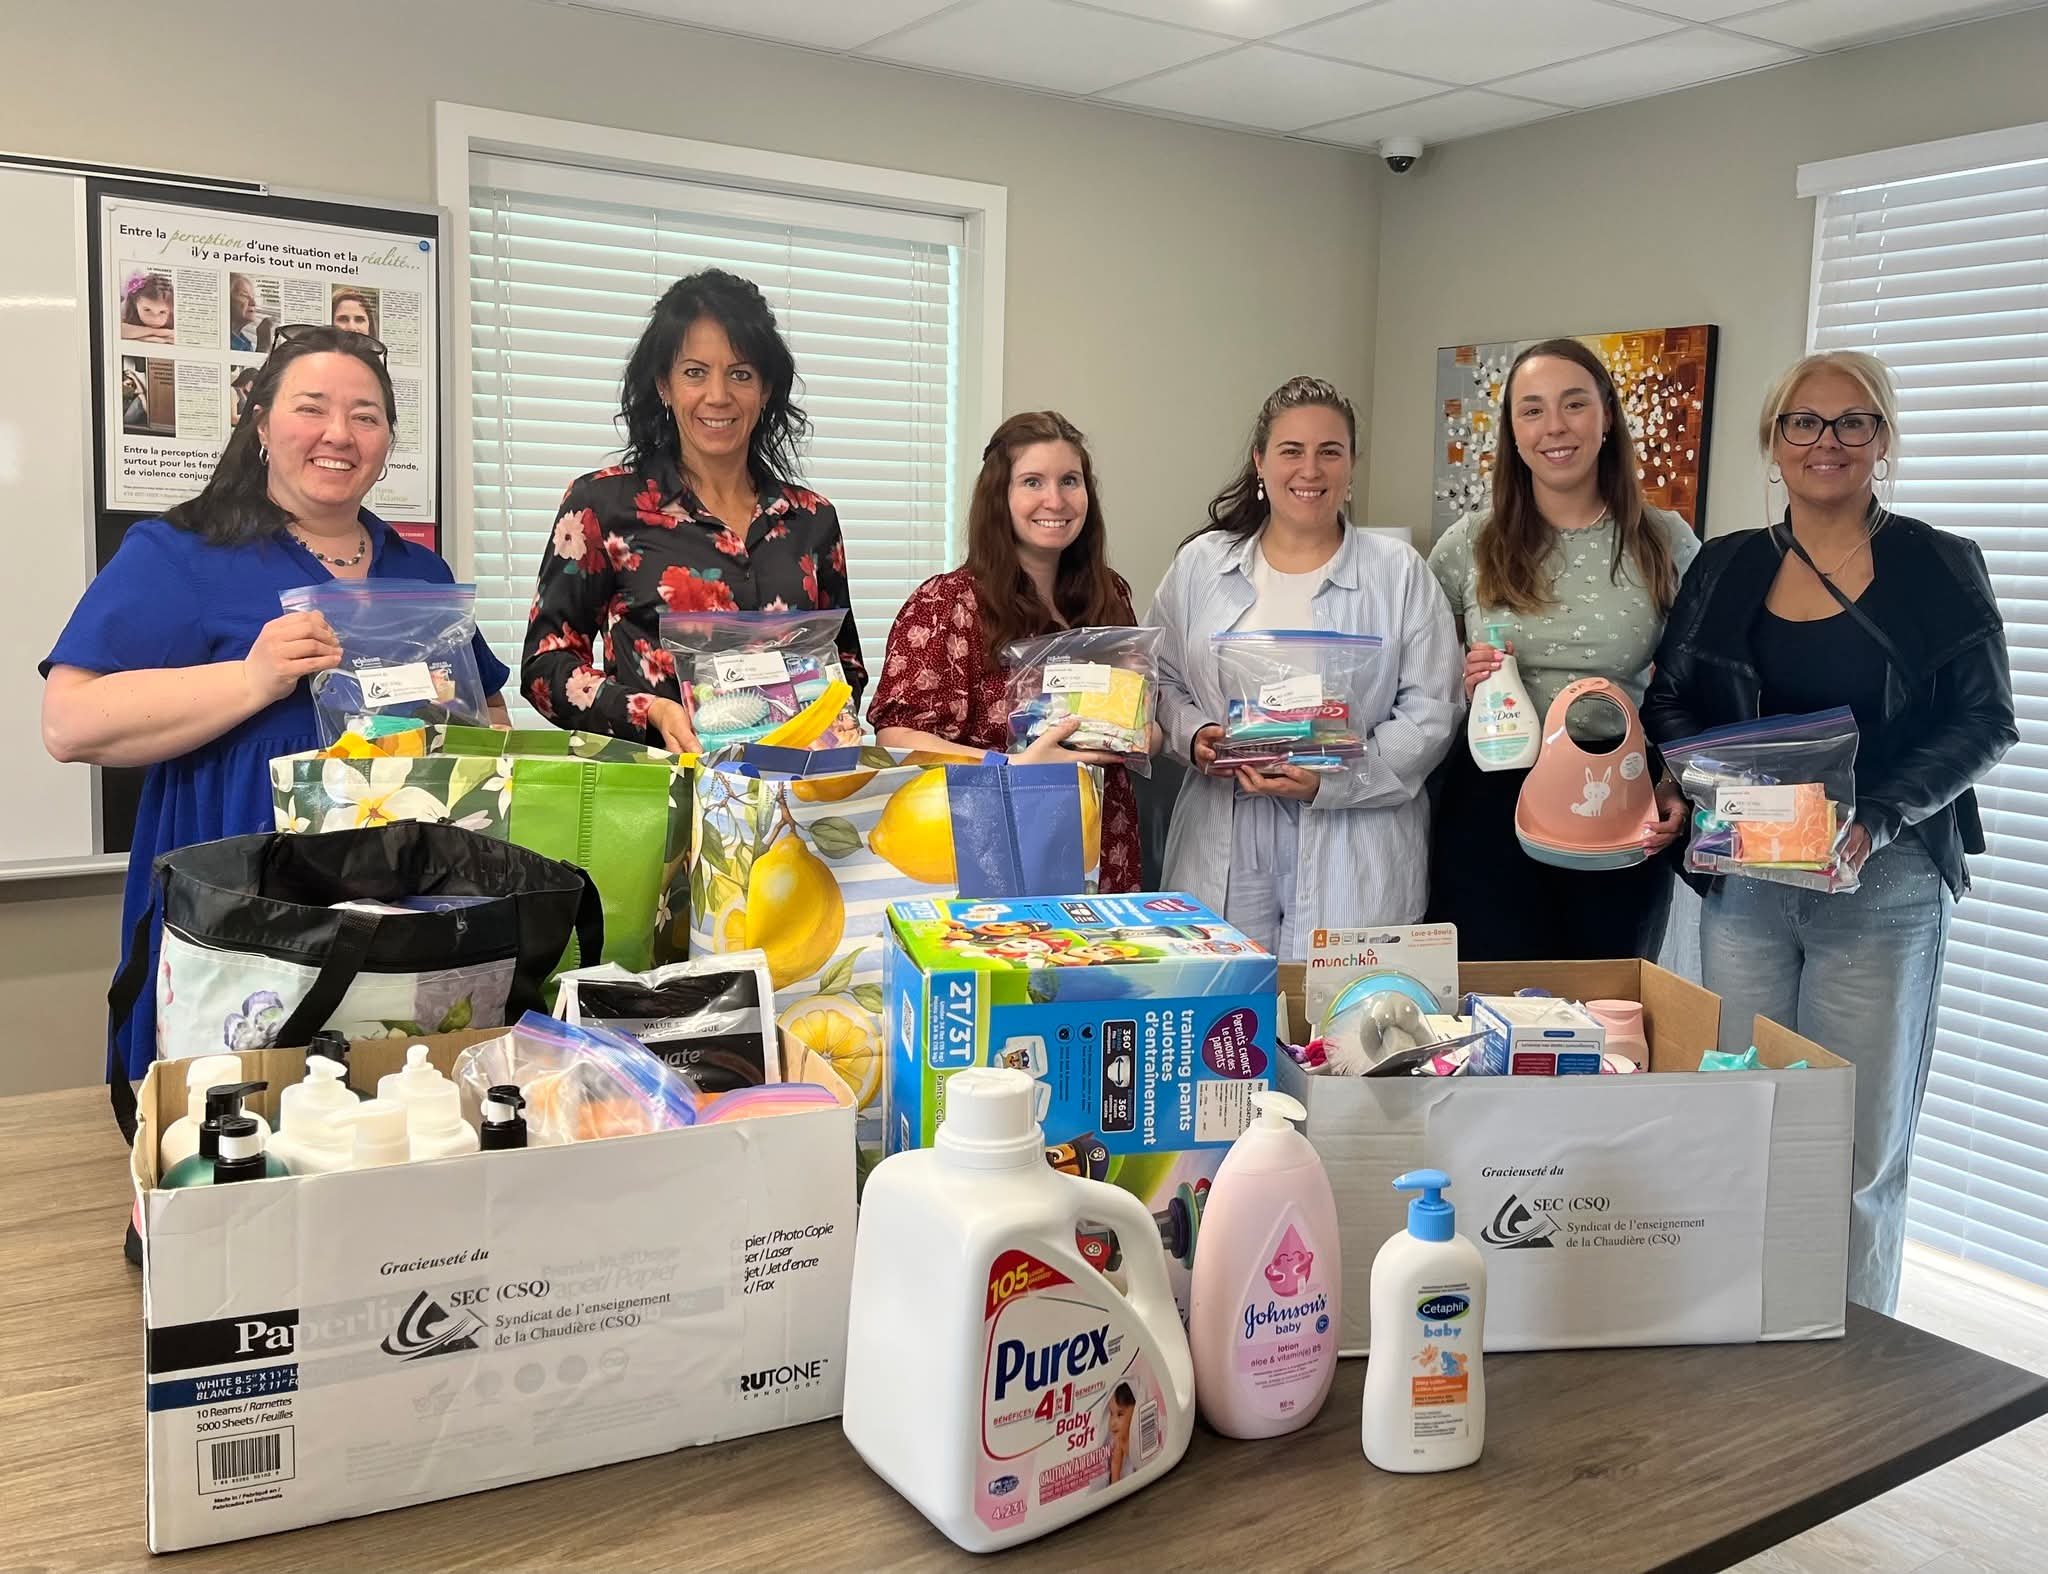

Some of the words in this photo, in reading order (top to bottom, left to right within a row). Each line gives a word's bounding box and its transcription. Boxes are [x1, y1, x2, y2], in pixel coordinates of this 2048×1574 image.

[120, 224, 152, 238] Entre
[156, 228, 167, 239] la
[160, 229, 243, 255] perception
[246, 240, 279, 253] d'une
[282, 244, 331, 259] situation
[191, 246, 198, 257] il
[201, 249, 209, 260] y
[213, 250, 220, 259] a
[224, 251, 266, 264] parfois
[269, 256, 294, 268] tout
[297, 260, 312, 270] un
[315, 262, 360, 275] monde!
[334, 251, 346, 261] et
[348, 251, 358, 262] la
[123, 445, 148, 454] Entre
[151, 447, 159, 455] la
[161, 449, 209, 459] perception
[123, 458, 157, 466] surtout
[160, 459, 181, 468] pour
[183, 460, 196, 468] les
[199, 461, 218, 469] fem
[123, 468, 136, 476] de
[139, 469, 177, 478] violence
[388, 462, 419, 471] monde,
[1497, 711, 1520, 721] Dove
[1312, 950, 1378, 968] munchkin
[946, 981, 974, 1061] 2T/3T
[1232, 1013, 1249, 1046] Parent's
[1161, 1009, 1174, 1081] culottes
[1176, 1009, 1195, 1078] training
[1208, 1036, 1225, 1068] parents
[1223, 1036, 1234, 1058] CHOIX
[1227, 1058, 1236, 1071] des
[1238, 1047, 1251, 1076] CHOICE
[936, 1075, 944, 1099] Pants
[1143, 1010, 1158, 1145] d'entraînement
[1176, 1082, 1193, 1131] pants
[1481, 1165, 1548, 1178] Gracieuseté
[1550, 1165, 1564, 1176] du
[1532, 1198, 1564, 1212] SEC
[1568, 1196, 1610, 1212] (CSQ)
[773, 1229, 804, 1244] Photo
[805, 1222, 834, 1239] Copie
[1567, 1220, 1611, 1234] Syndicat
[1614, 1220, 1627, 1231] de
[1629, 1218, 1705, 1232] l'enseignement
[1566, 1238, 1579, 1248] de
[1581, 1237, 1591, 1247] la
[1593, 1235, 1645, 1247] Chaudière
[1648, 1234, 1681, 1246] (CSQ)
[380, 1250, 467, 1276] Gracieuseté
[471, 1248, 489, 1261] du
[765, 1246, 793, 1261] Laser
[766, 1261, 782, 1276] Jet
[782, 1257, 819, 1272] d'encre
[450, 1287, 490, 1308] SEC
[496, 1279, 550, 1303] (CSQ)
[756, 1279, 775, 1293] Fax
[991, 1261, 1029, 1307] 105
[495, 1308, 553, 1329] Syndicat
[556, 1306, 572, 1319] de
[575, 1292, 671, 1317] l'enseignement
[1244, 1294, 1326, 1339] Johnson's
[1422, 1301, 1464, 1315] Cetaphil
[495, 1333, 510, 1346] de
[514, 1330, 527, 1343] la
[530, 1320, 597, 1341] Chaudière
[599, 1313, 641, 1331] (CSQ)
[1275, 1322, 1301, 1335] baby
[1423, 1322, 1462, 1339] baby
[1250, 1358, 1268, 1367] aloe
[1269, 1356, 1275, 1364] &
[1277, 1348, 1311, 1362] vitamin(e)
[1278, 1343, 1299, 1353] lotion
[994, 1323, 1110, 1402] Purex
[195, 1377, 232, 1391] WHITE
[259, 1372, 267, 1381] X
[740, 1360, 821, 1393] RUTONE
[196, 1388, 233, 1401] BLANC
[258, 1382, 266, 1392] X
[1034, 1389, 1055, 1421] 4
[1062, 1382, 1073, 1414] 1
[1075, 1381, 1105, 1398] BENEFITS
[196, 1409, 208, 1419] 10
[210, 1405, 242, 1418] Reams
[250, 1398, 292, 1411] Ramettes
[197, 1420, 221, 1432] 5000
[222, 1415, 254, 1428] Sheets
[261, 1410, 293, 1423] Feuilles
[1056, 1411, 1092, 1436] Baby
[1067, 1427, 1095, 1451] Soft
